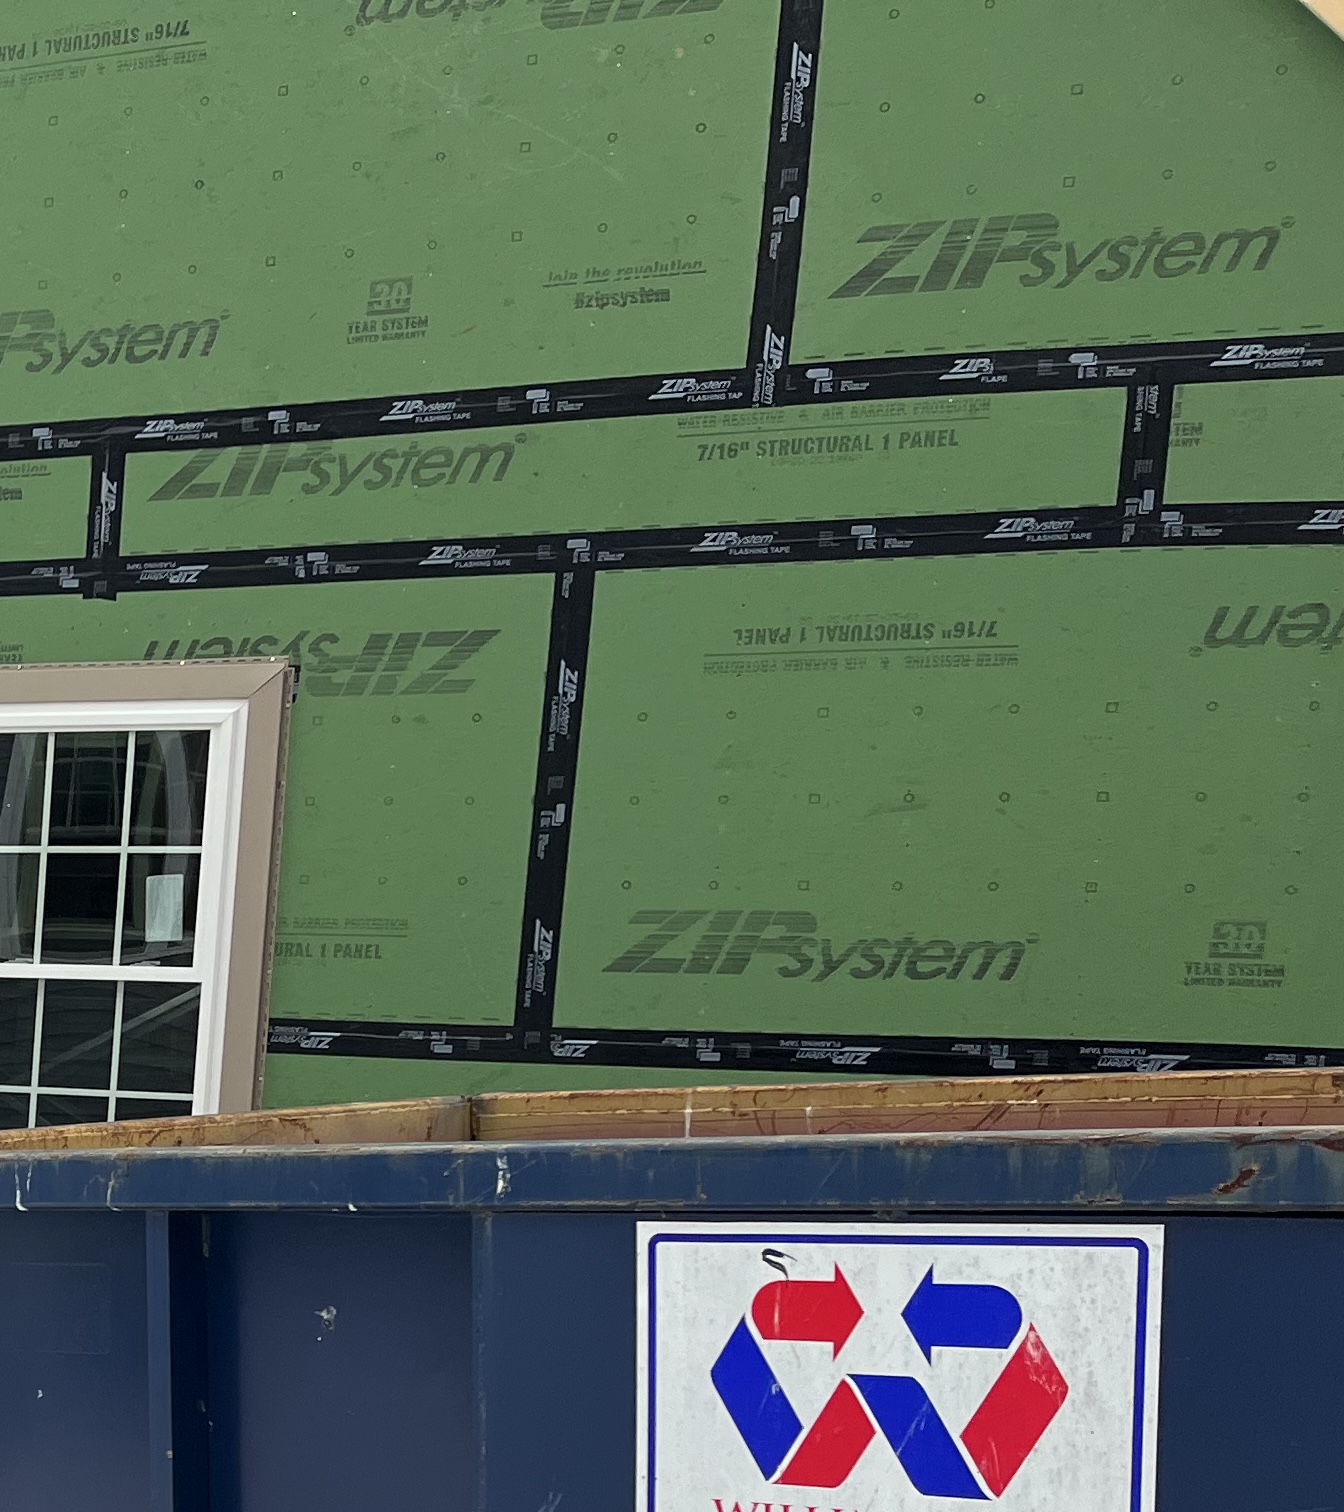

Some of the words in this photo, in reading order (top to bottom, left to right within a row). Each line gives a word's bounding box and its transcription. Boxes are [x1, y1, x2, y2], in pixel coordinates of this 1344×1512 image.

[145, 20, 190, 42] 7/16"
[32, 41, 39, 57] 1
[45, 27, 140, 56] STRUCTURAL
[348, 320, 377, 334] YEAR
[382, 315, 429, 331] SYSTEM
[453, 412, 471, 420] TAPE
[697, 442, 750, 462] 7/16"
[756, 433, 874, 457] STRUCTURAL
[882, 434, 891, 450] 1
[898, 428, 959, 449] PANEL
[1070, 532, 1092, 540] TAPE
[492, 558, 511, 566] TAPE
[734, 627, 792, 646] PANEL
[799, 627, 807, 643] 1
[815, 622, 936, 643] STRUCTURAL
[942, 620, 998, 640] 7/16"
[333, 943, 382, 959] PANEL
